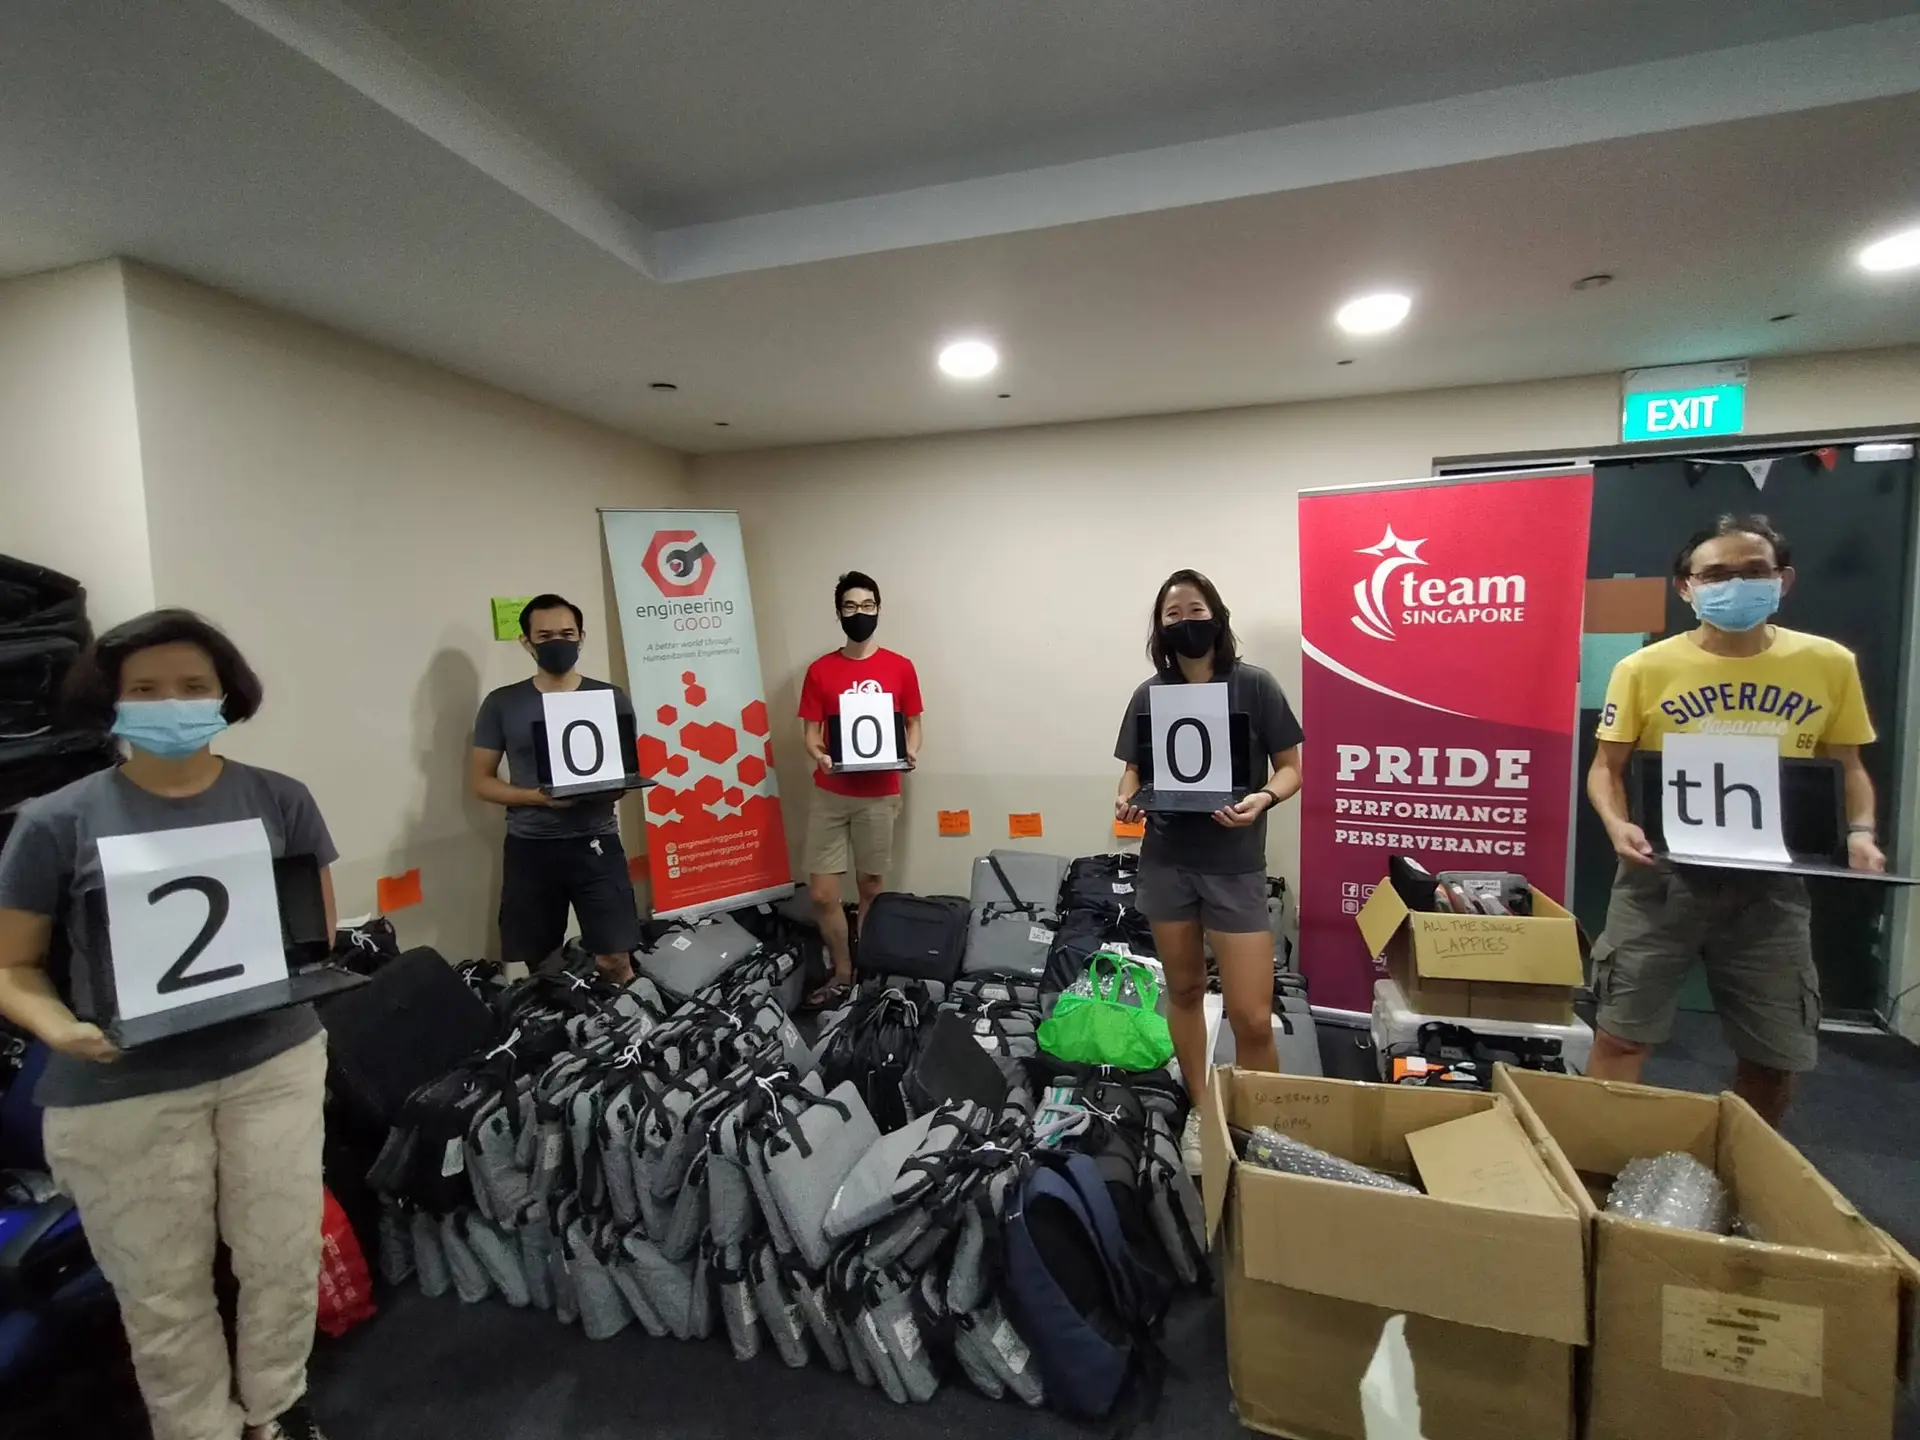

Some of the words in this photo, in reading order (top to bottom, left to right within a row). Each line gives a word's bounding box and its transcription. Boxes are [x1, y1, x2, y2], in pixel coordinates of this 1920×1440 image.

[1646, 395, 1719, 433] EXIT
[1400, 571, 1525, 607] team
[636, 598, 734, 619] engineering
[1402, 608, 1525, 625] SINGAPORE
[673, 615, 723, 632] GOOD
[646, 644, 654, 652] A
[655, 641, 678, 651] better
[681, 638, 703, 648] world
[1661, 682, 1823, 726] SUPERDRY
[562, 719, 604, 777] 0
[851, 714, 883, 759] 0
[1796, 733, 1815, 749] 66
[1166, 717, 1212, 784] 0
[1336, 744, 1531, 789] PRIDE
[1668, 763, 1763, 830] th
[1335, 798, 1528, 825] PERFORMANCE
[678, 829, 759, 850] engineeringgood.org
[679, 840, 760, 862] engineeringgood.org
[1335, 829, 1526, 857] PERSERVERANCE
[681, 853, 754, 874] @engineeringgood
[147, 875, 245, 995] 2
[1423, 919, 1447, 932] ALL
[1450, 919, 1477, 932] THE
[1480, 920, 1526, 935] SINGLE
[1433, 937, 1510, 955] LAPPIES
